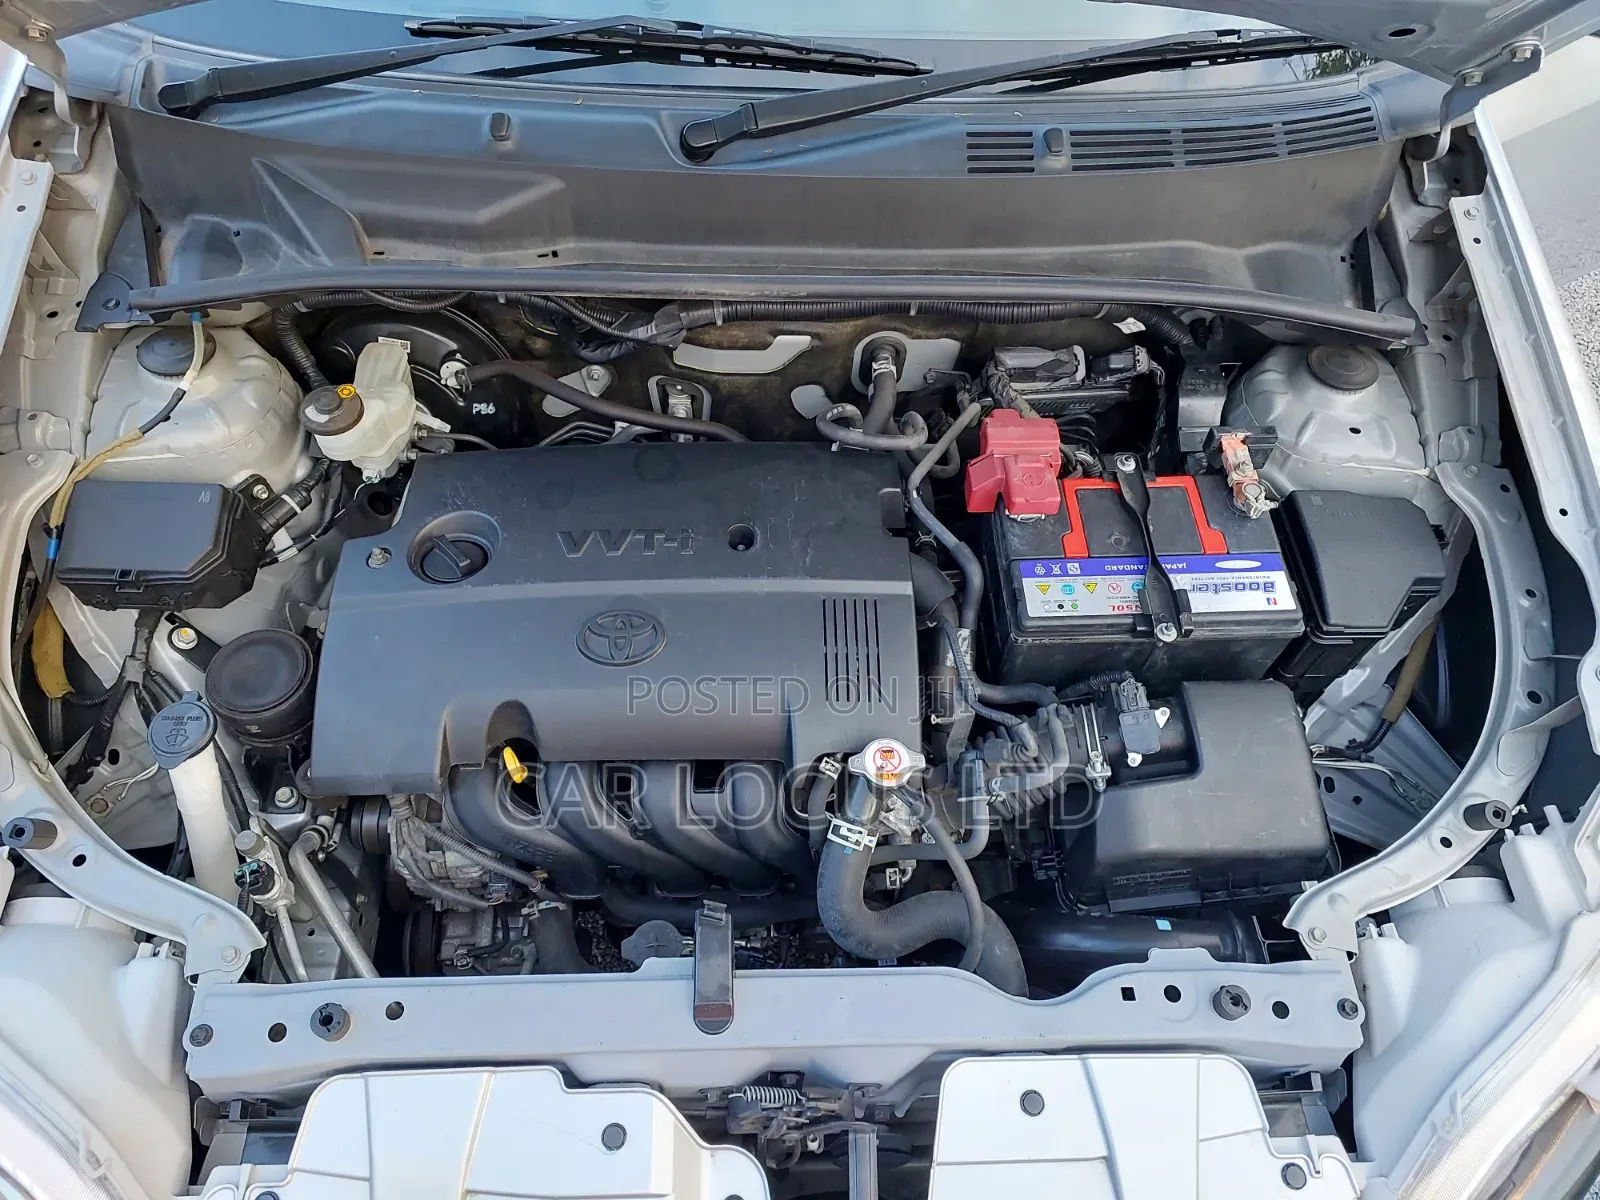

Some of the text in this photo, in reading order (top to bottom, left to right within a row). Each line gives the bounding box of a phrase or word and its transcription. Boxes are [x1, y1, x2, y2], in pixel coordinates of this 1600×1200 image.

[473, 403, 496, 414] PS6
[556, 528, 694, 557] VVT-i
[1189, 581, 1276, 595] Booster
